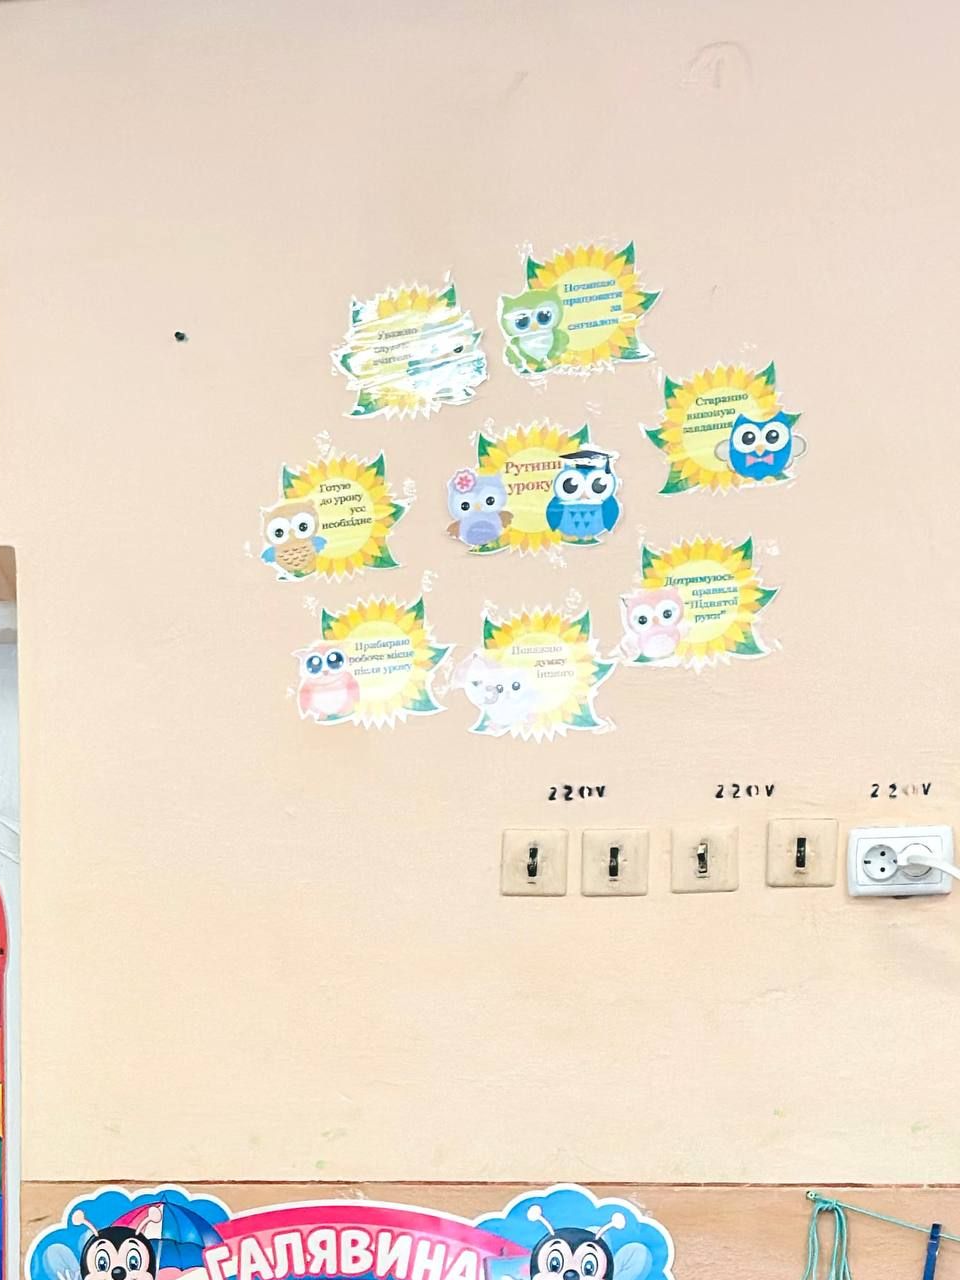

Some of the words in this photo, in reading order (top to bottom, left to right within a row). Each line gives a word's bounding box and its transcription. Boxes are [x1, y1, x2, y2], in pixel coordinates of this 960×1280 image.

[504, 459, 562, 476] Рутини
[319, 482, 352, 494] Готую
[508, 478, 554, 496] уроку
[548, 784, 606, 801] 220V
[715, 783, 775, 799] 220V
